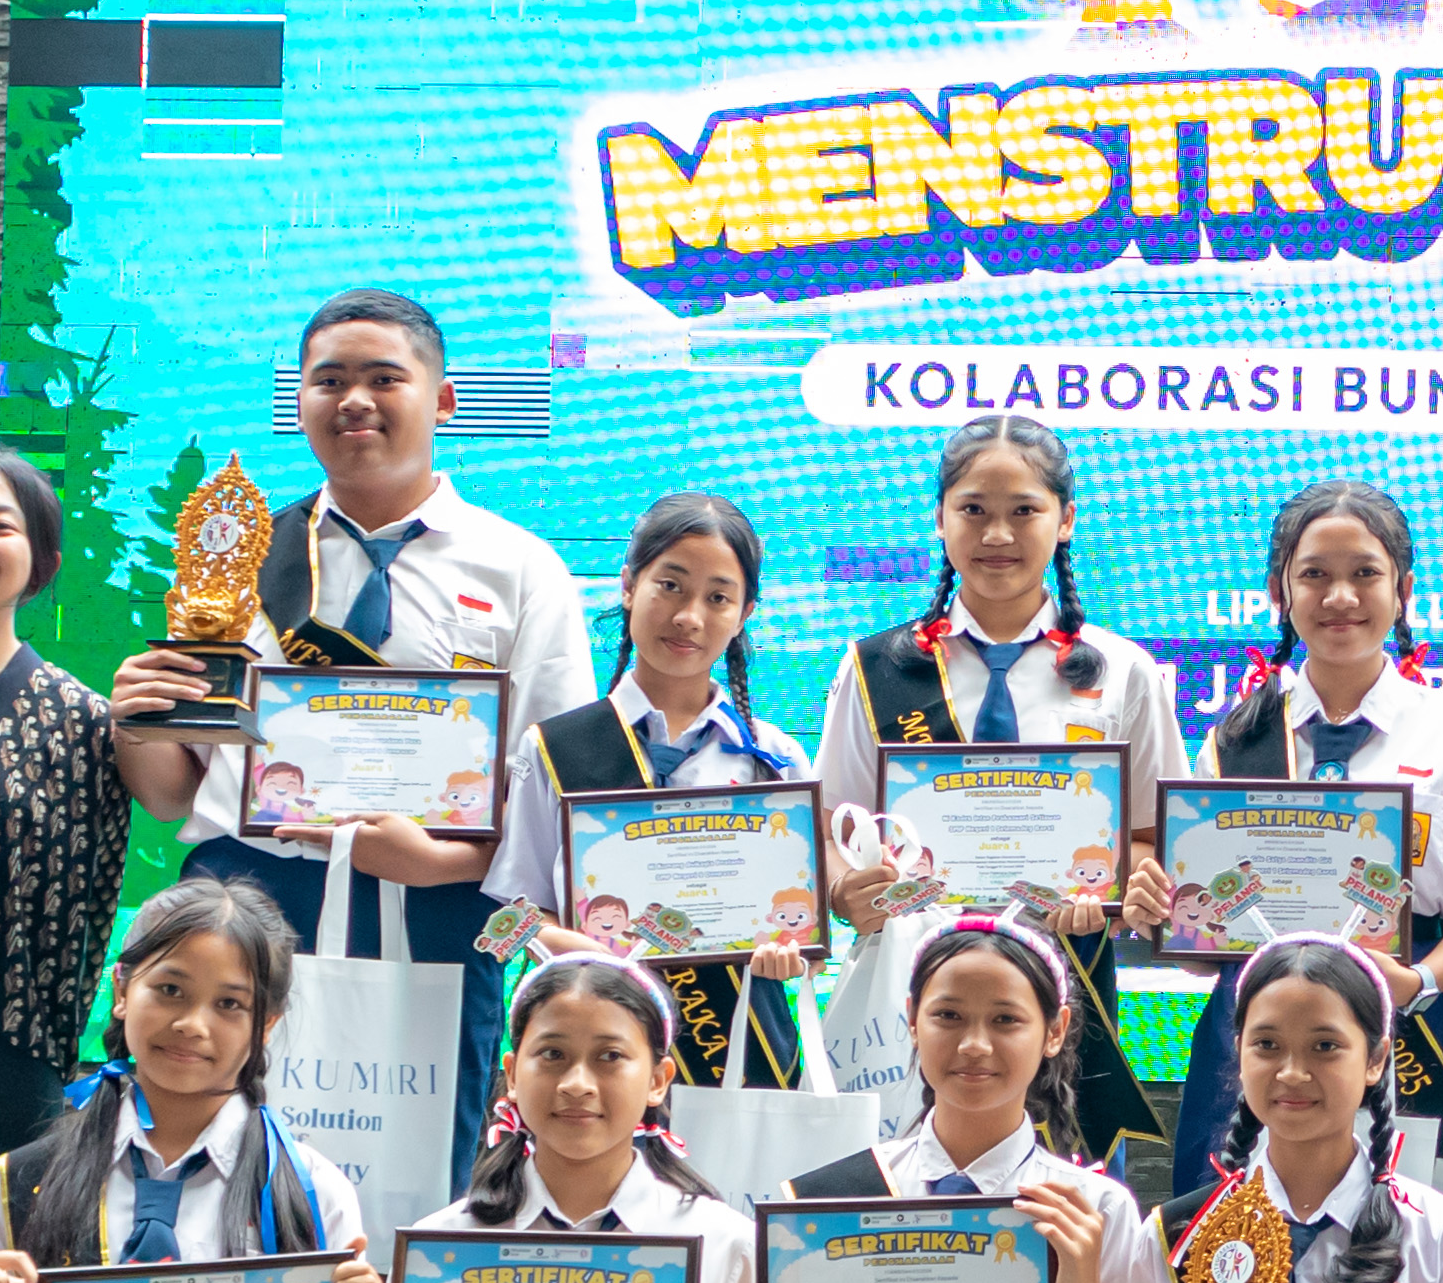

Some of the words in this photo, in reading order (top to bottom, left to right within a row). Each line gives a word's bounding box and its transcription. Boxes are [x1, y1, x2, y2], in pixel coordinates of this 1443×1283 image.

[864, 359, 1304, 417] KOLABORASI
[308, 694, 450, 716] SERTIFIKAT
[934, 770, 1072, 792] SERTIFIKAT
[624, 814, 766, 841] SERTIFIKAT
[1216, 809, 1356, 831] SERTIFIKAT
[1213, 880, 1264, 918] PELANGI
[1346, 876, 1398, 911] PELANGI
[282, 1056, 439, 1097] KUMARI
[282, 1106, 383, 1134] Solution
[825, 1230, 991, 1260] SERTIFIKAT
